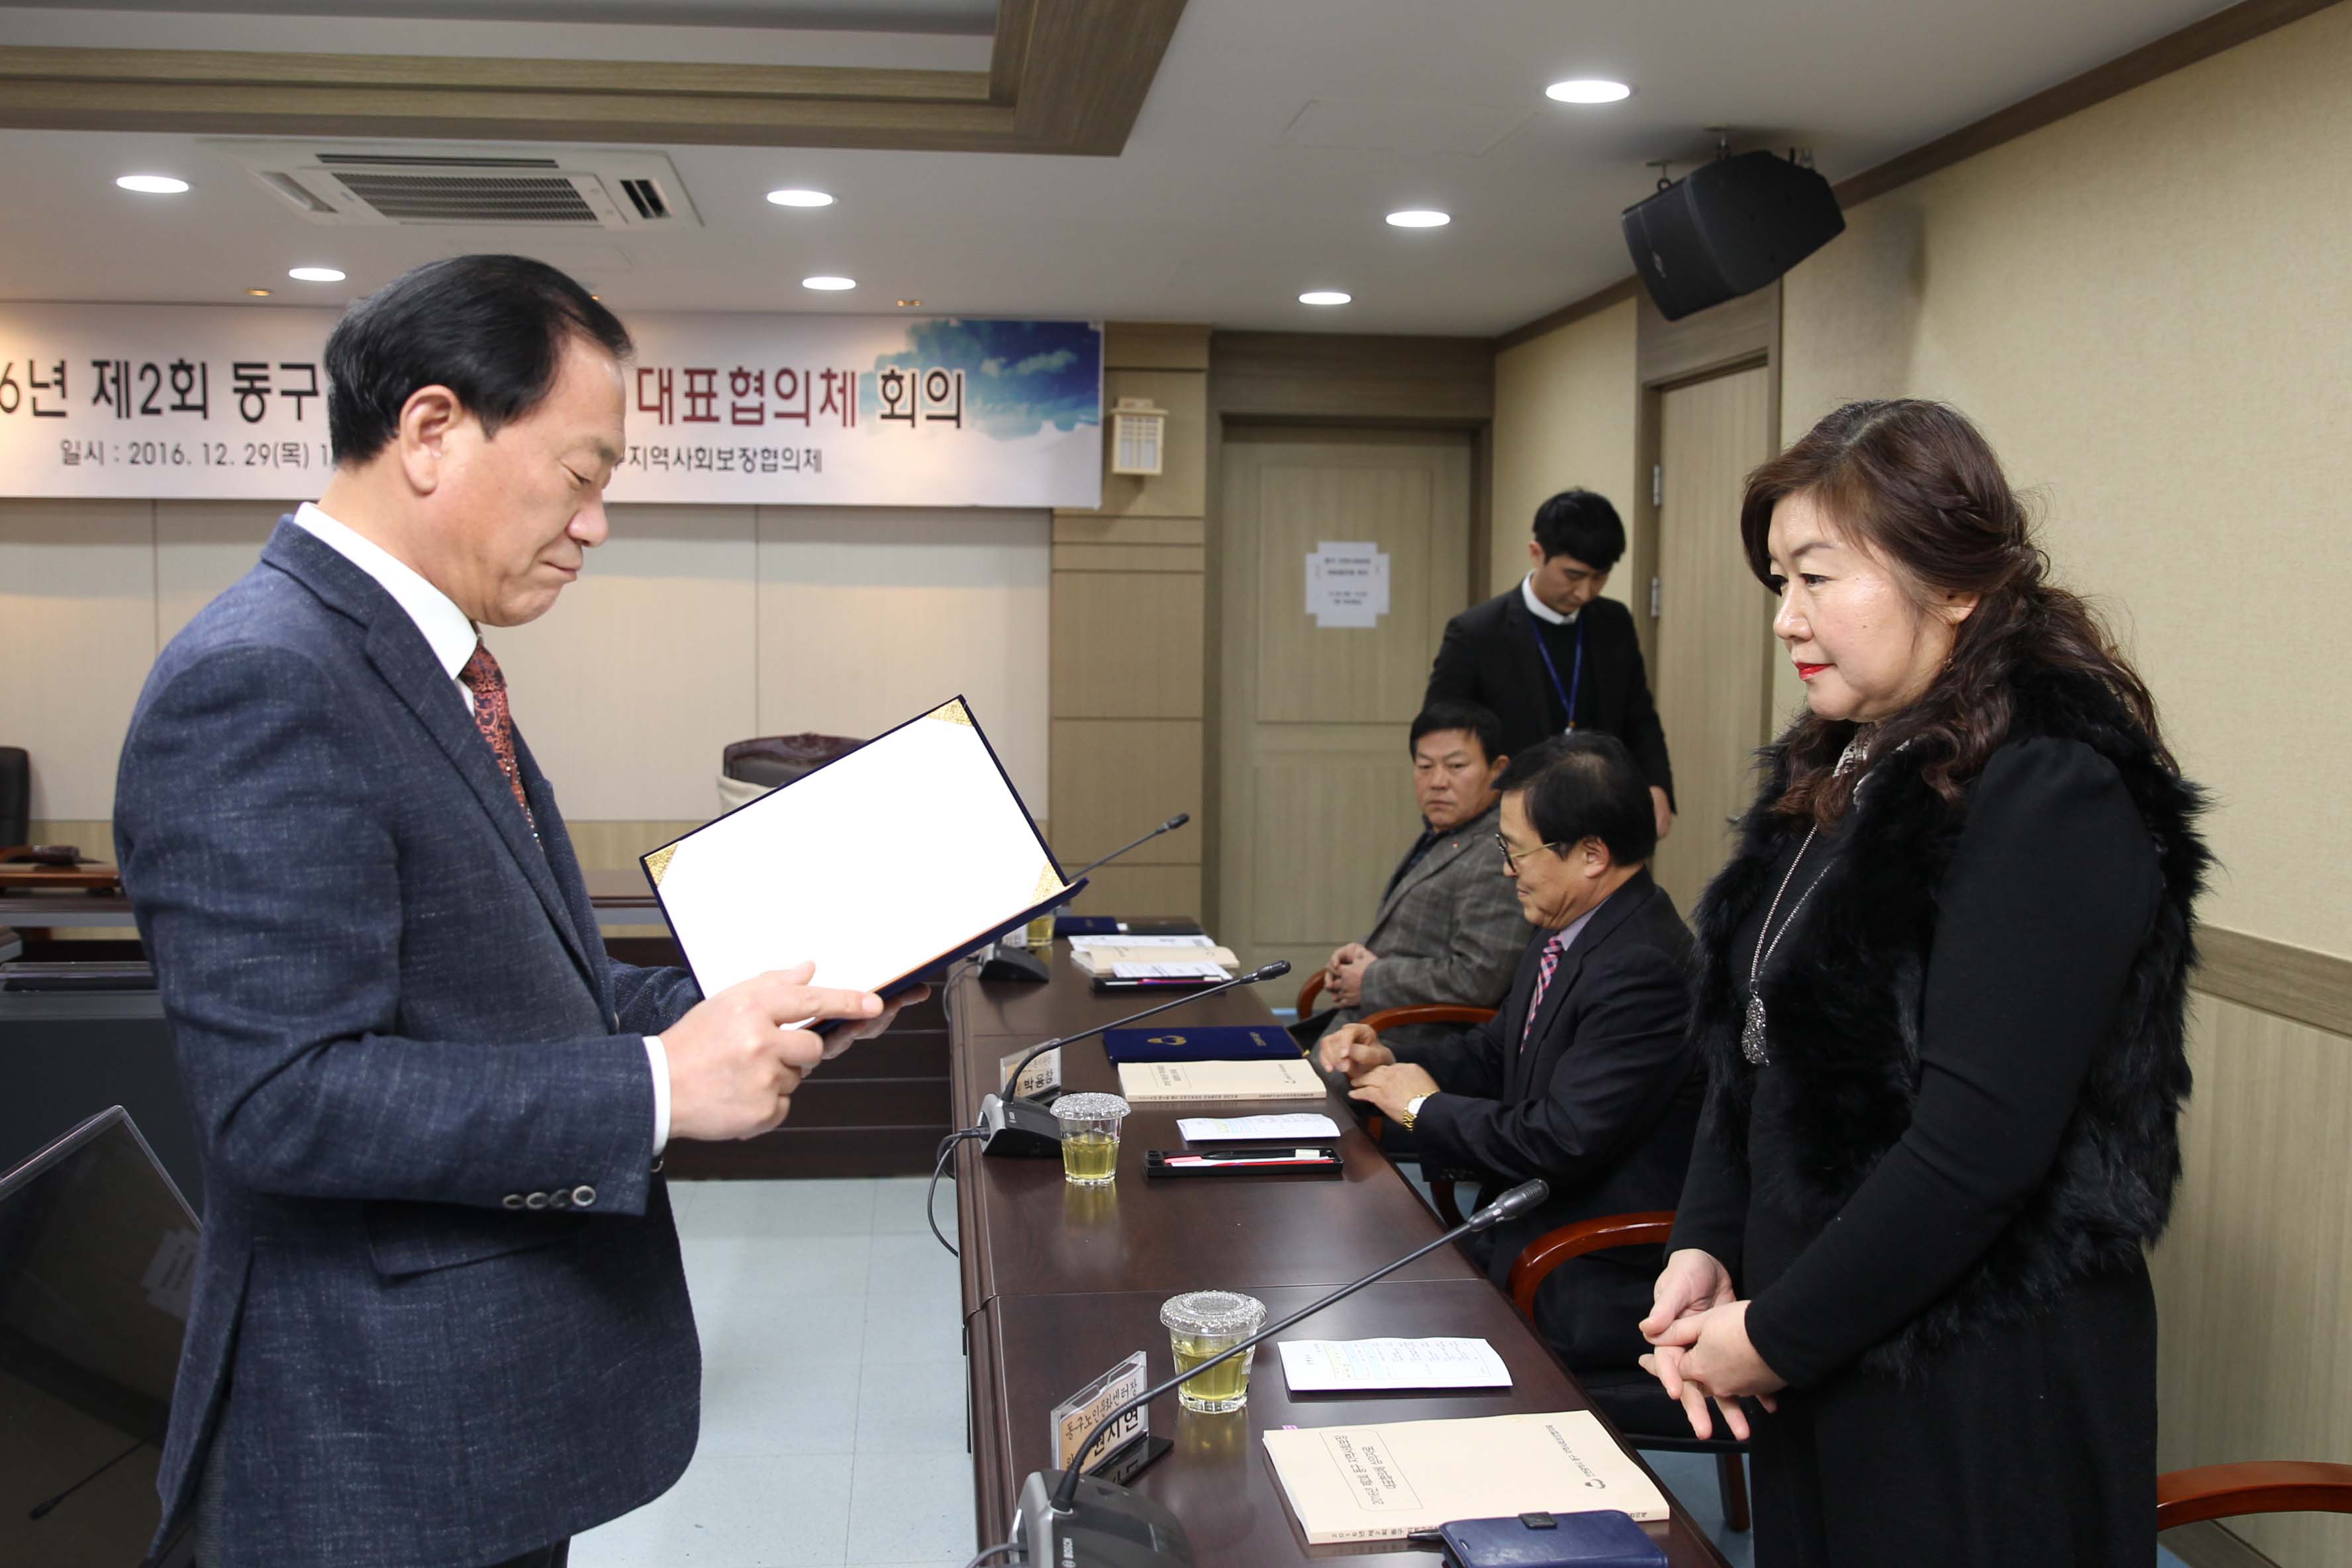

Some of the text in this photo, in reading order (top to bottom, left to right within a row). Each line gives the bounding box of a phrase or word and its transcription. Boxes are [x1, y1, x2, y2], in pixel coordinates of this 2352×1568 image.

[91, 358, 209, 420] 제2회
[232, 362, 319, 423] 동구
[637, 366, 856, 428] 대표협의체
[879, 368, 963, 429] 회의
[60, 438, 105, 466] 일시
[128, 441, 191, 466] 2016.
[202, 442, 235, 466] 12.
[244, 442, 309, 469] 29(목)
[613, 445, 822, 474] 지역사회보장협의체
[1351, 1464, 1367, 1473] 동구
